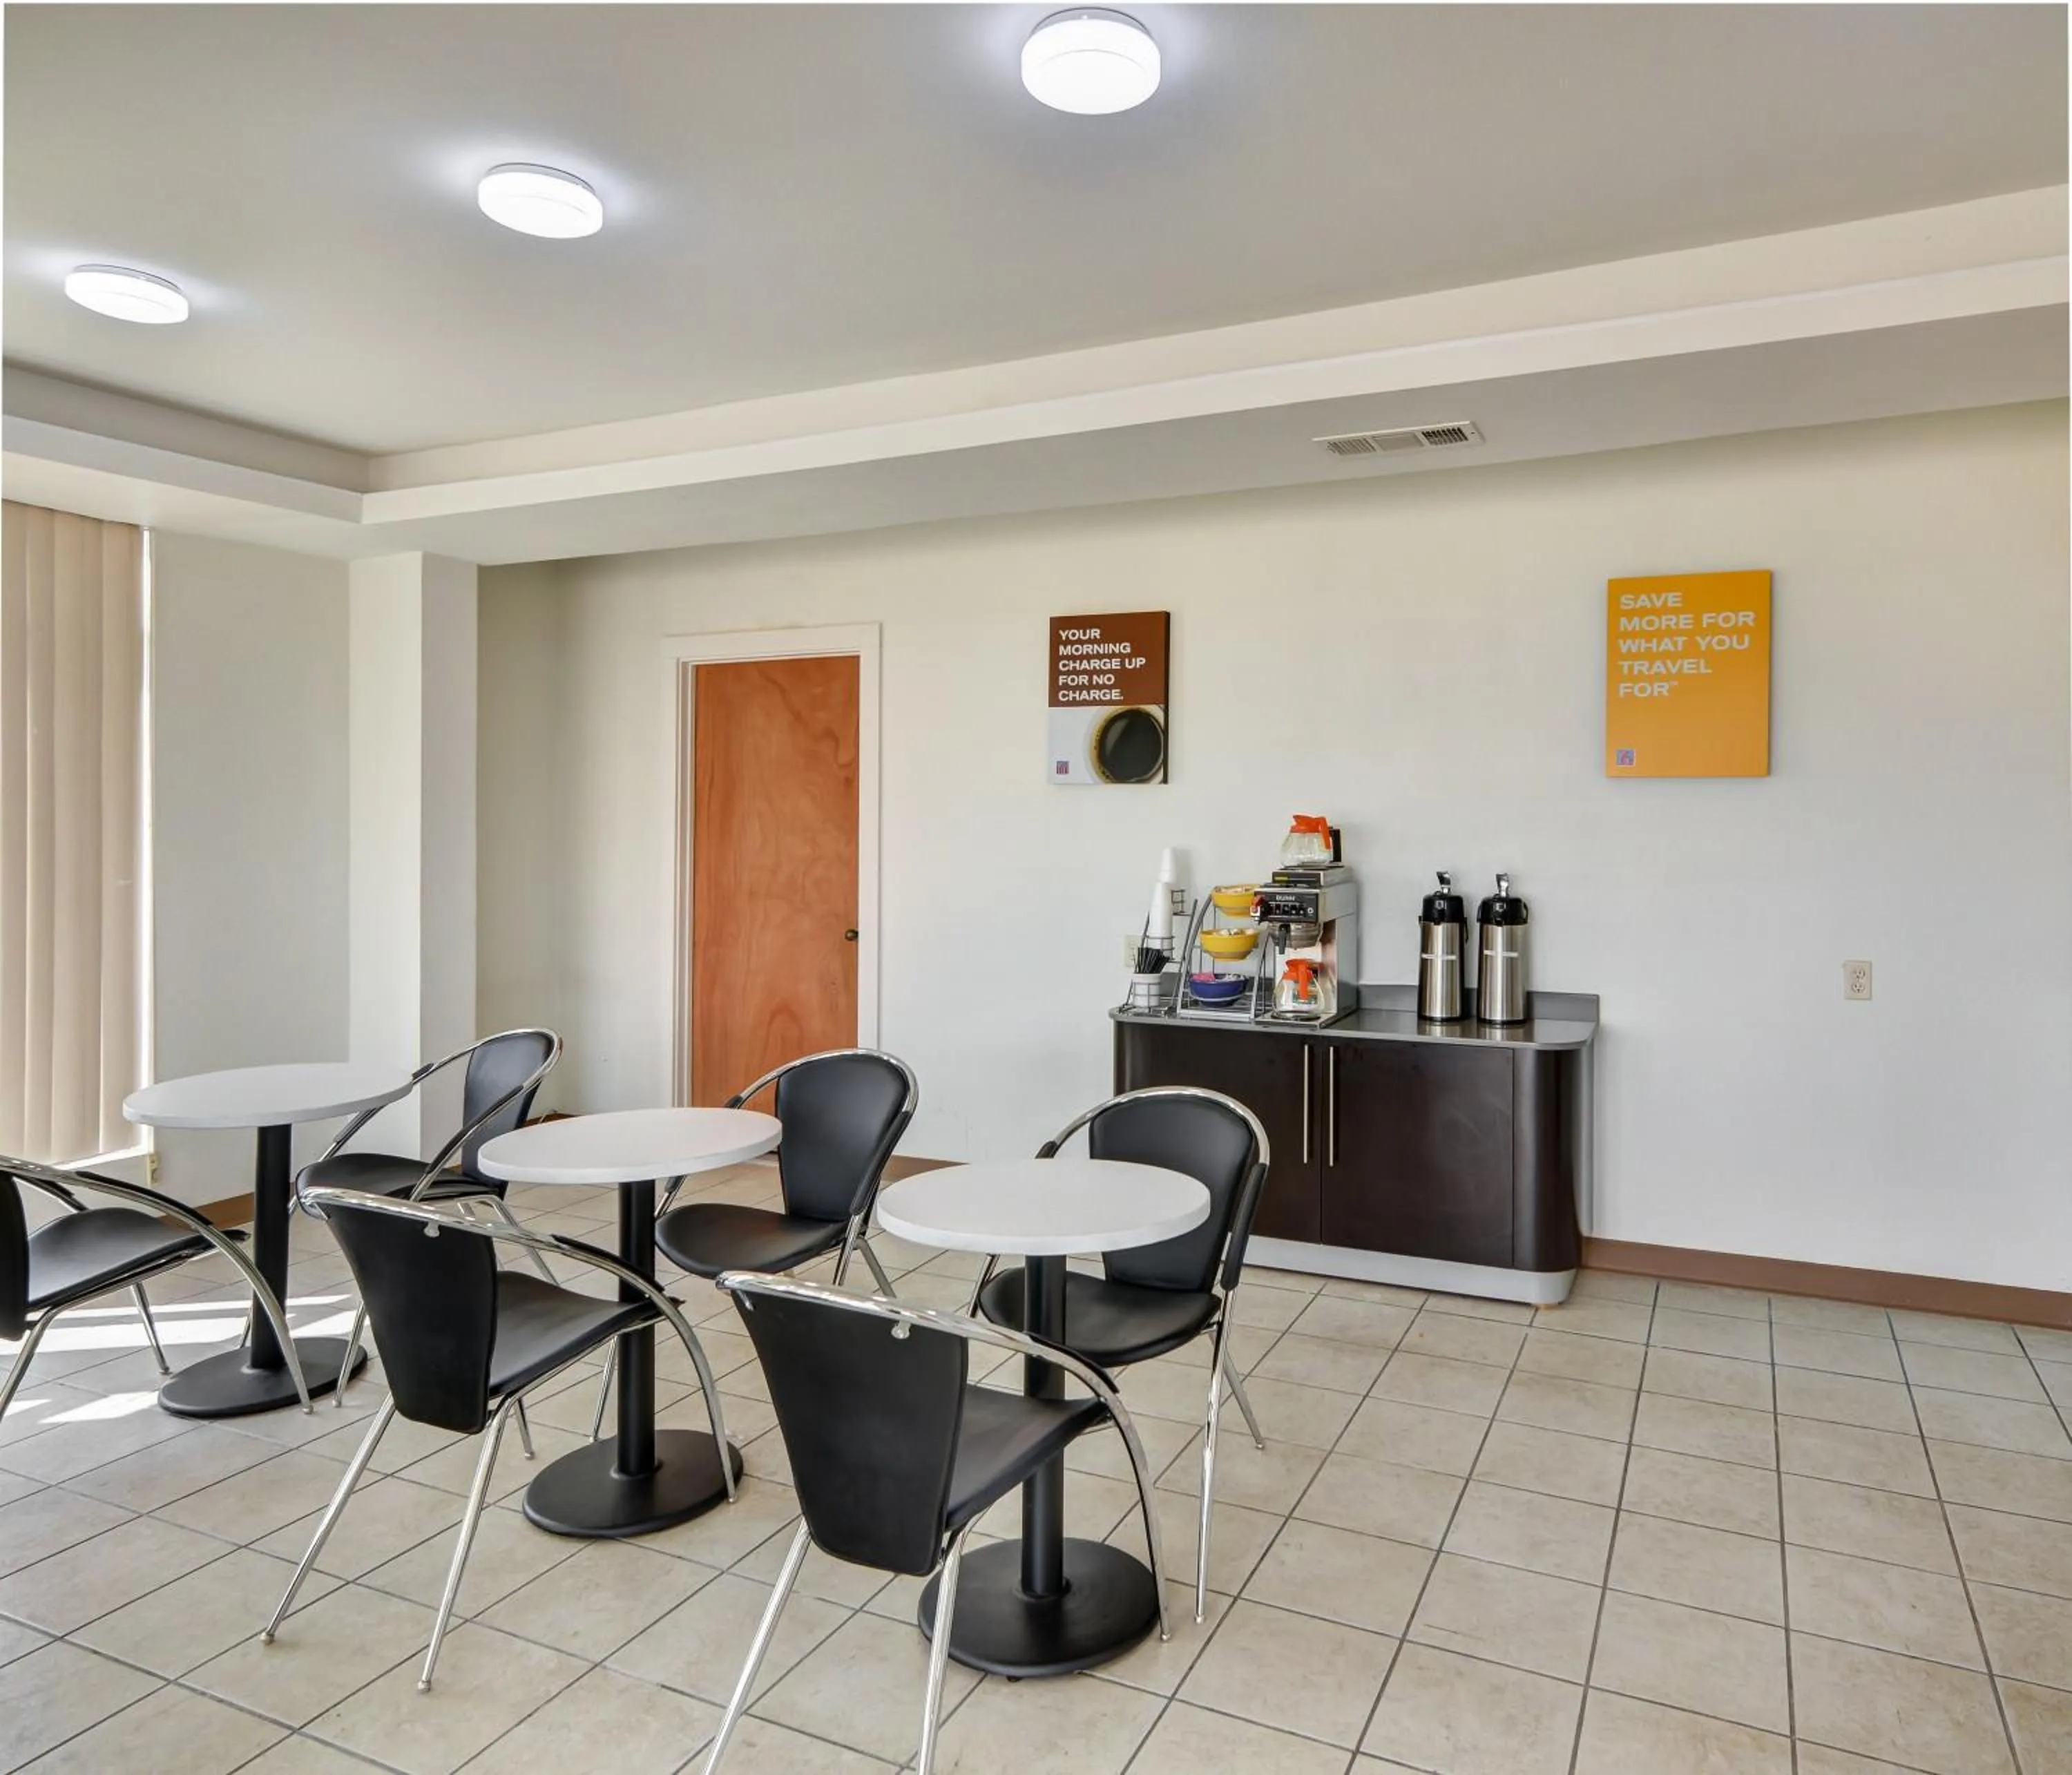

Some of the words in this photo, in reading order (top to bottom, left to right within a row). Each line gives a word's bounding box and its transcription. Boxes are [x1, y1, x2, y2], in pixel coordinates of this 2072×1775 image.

[1620, 593, 1682, 609] SAVE
[1620, 614, 1694, 631] MORE
[1702, 611, 1756, 628] FOR
[1059, 629, 1100, 641] YOUR
[1059, 643, 1131, 655] MORNING
[1618, 636, 1688, 653] WHAT
[1695, 634, 1749, 651] YOU
[1059, 658, 1121, 671] CHARGE
[1125, 658, 1146, 669] UP
[1618, 659, 1712, 675] TRAVEL
[1059, 674, 1088, 686] FOR
[1093, 674, 1115, 685] NO
[1058, 689, 1124, 701] CHARGE.
